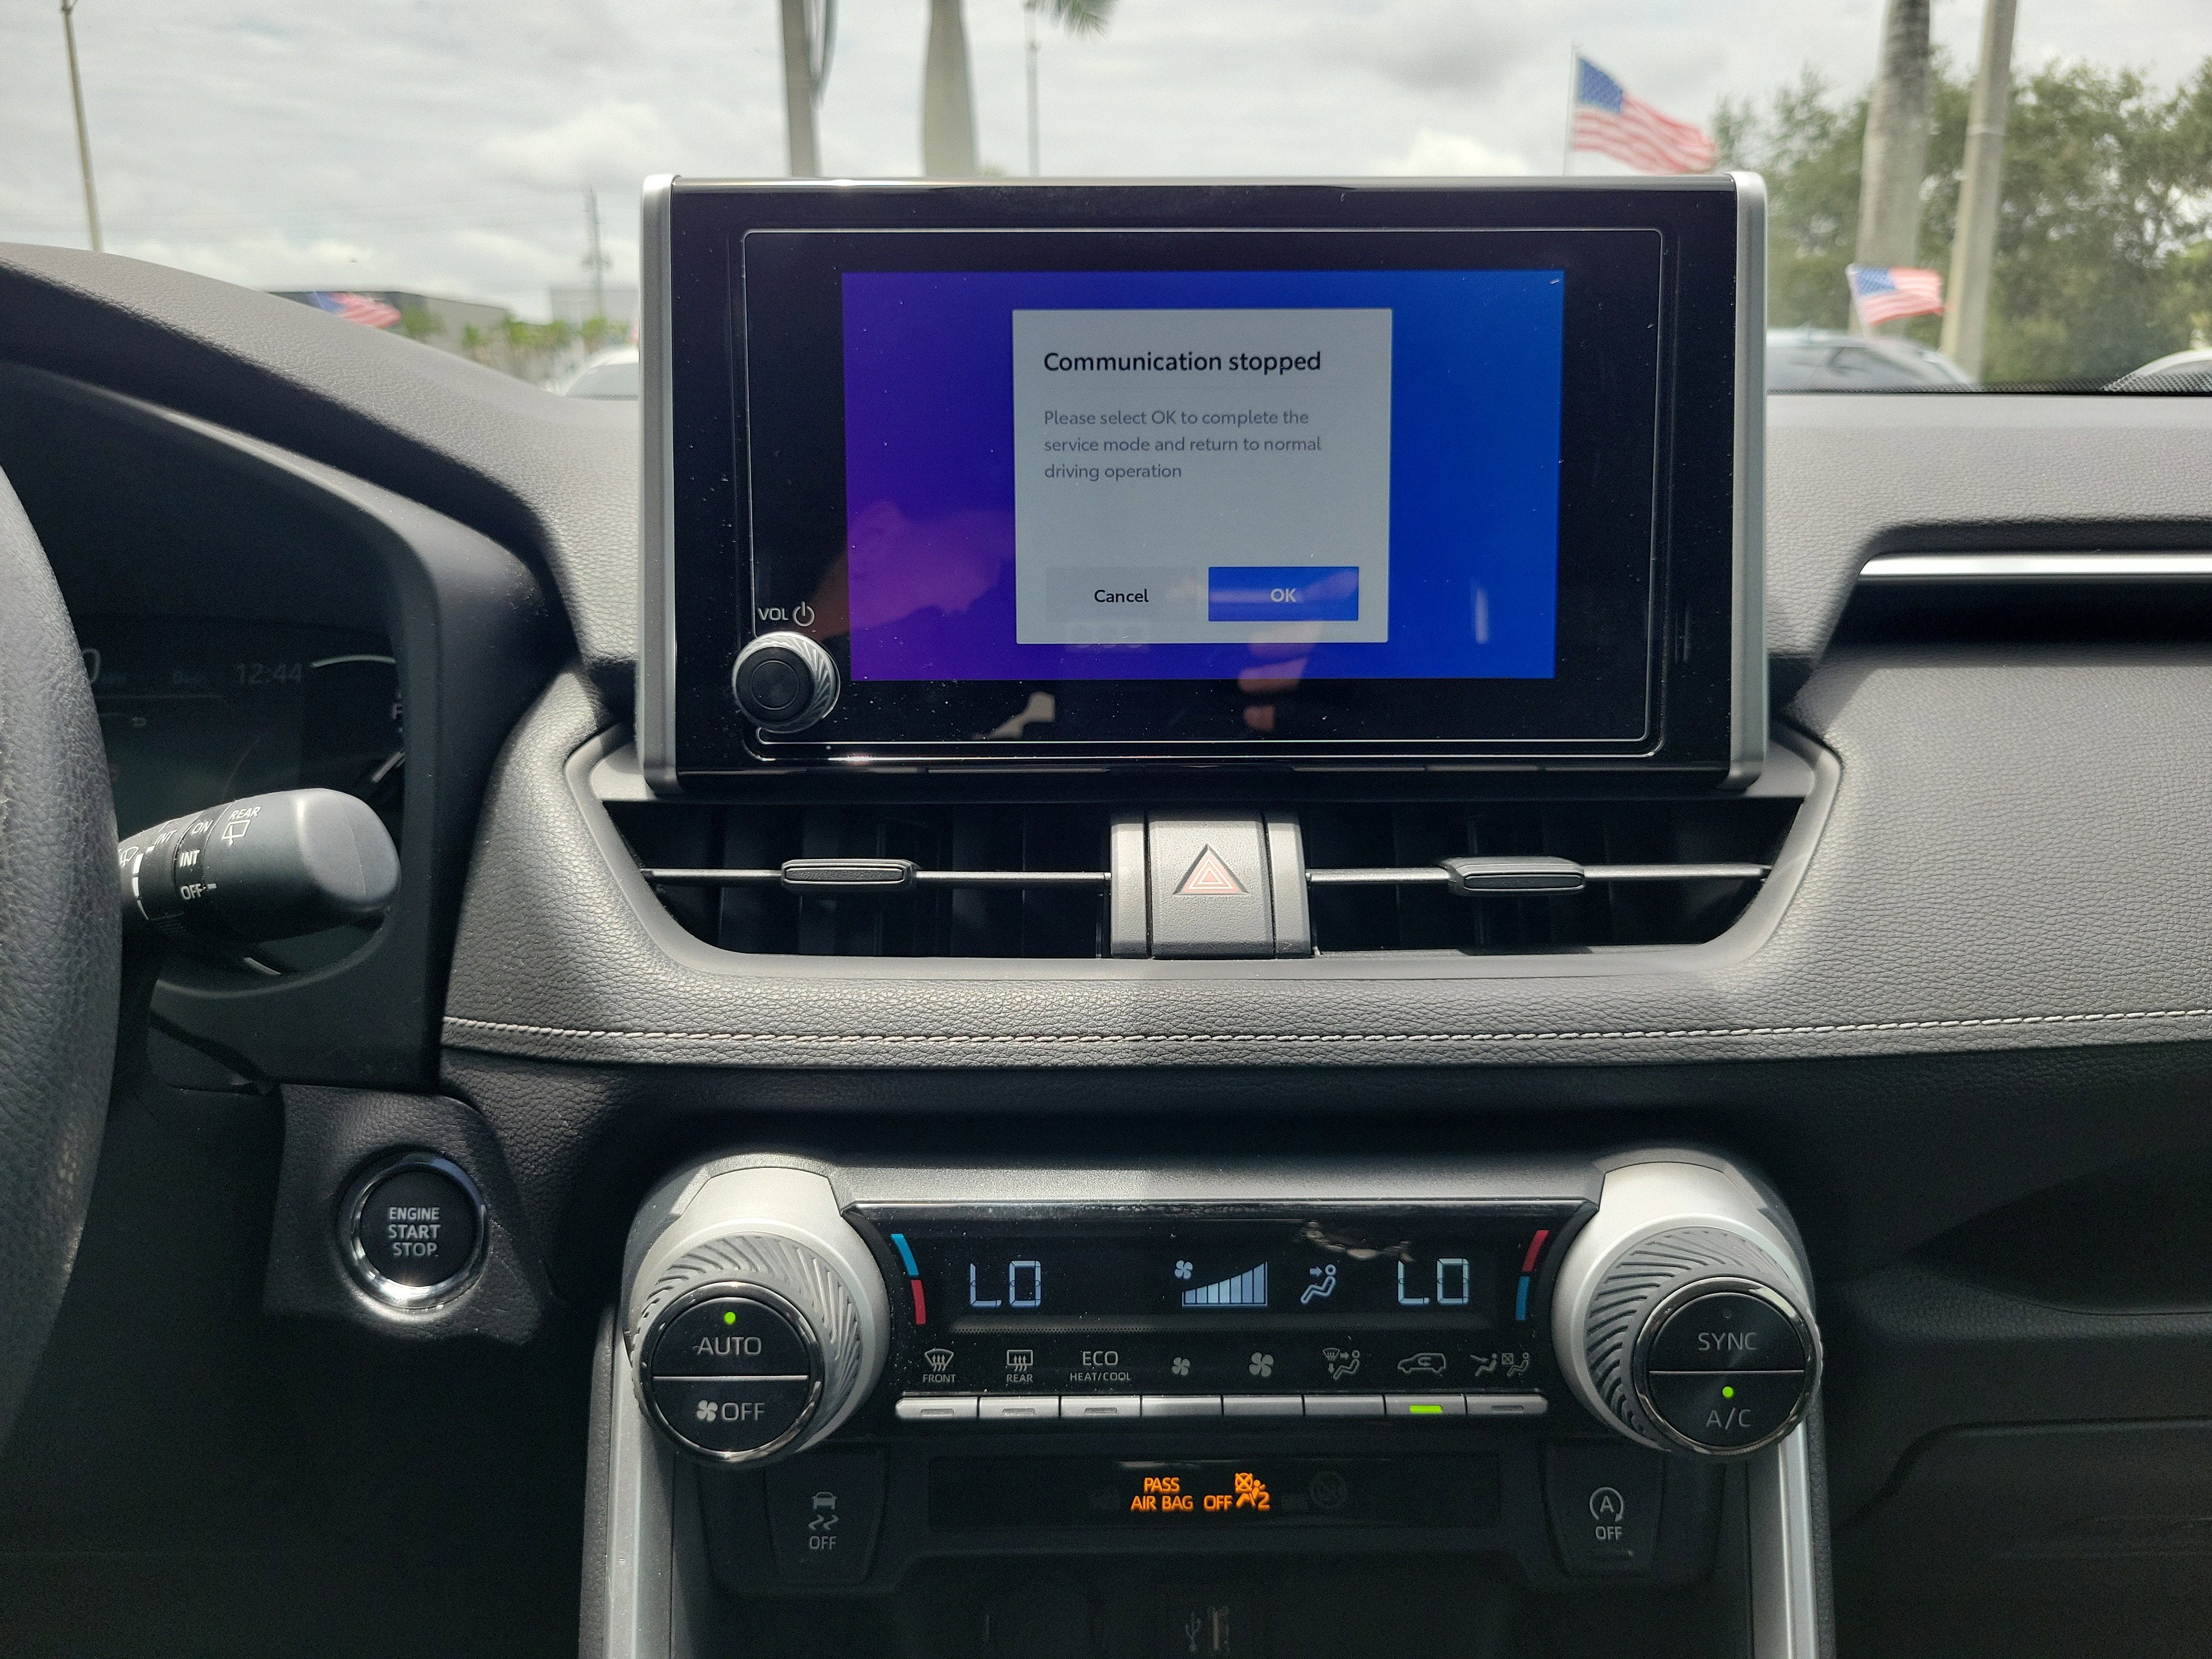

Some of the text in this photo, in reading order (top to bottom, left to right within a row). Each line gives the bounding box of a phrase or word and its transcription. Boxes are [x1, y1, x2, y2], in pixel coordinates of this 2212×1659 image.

[1044, 351, 1321, 375] Communication stopped
[1045, 409, 1309, 428] Please select OK to complete the
[1045, 436, 1322, 452] service mode and return to normal
[1045, 464, 1182, 482] driving operation
[1093, 588, 1149, 603] Cancel
[1270, 588, 1296, 602] OK
[758, 607, 789, 620] VOL
[236, 662, 303, 684] 12:44
[228, 806, 262, 821] REAR
[192, 820, 214, 834] ON
[154, 830, 178, 845] INT
[179, 849, 201, 868] INT
[180, 883, 203, 900] OFF
[389, 1207, 439, 1221] ENGINE
[388, 1224, 441, 1239] START
[392, 1242, 438, 1257] STOP
[969, 1260, 1041, 1307] LO
[1397, 1257, 1470, 1305] LO
[697, 1336, 762, 1356] AUTO
[1697, 1332, 1757, 1351] SYNC
[1082, 1351, 1119, 1366] ECO
[922, 1373, 956, 1383] FRONT
[1006, 1373, 1034, 1383] REAR
[1070, 1372, 1131, 1381] HEAT/COOL
[721, 1402, 765, 1421] OFF
[1706, 1409, 1752, 1429] A/C
[1144, 1477, 1181, 1493] PASS
[1131, 1495, 1233, 1511] AIR BAG OFF
[1595, 1526, 1623, 1540] OFF
[809, 1536, 837, 1550] OFF
